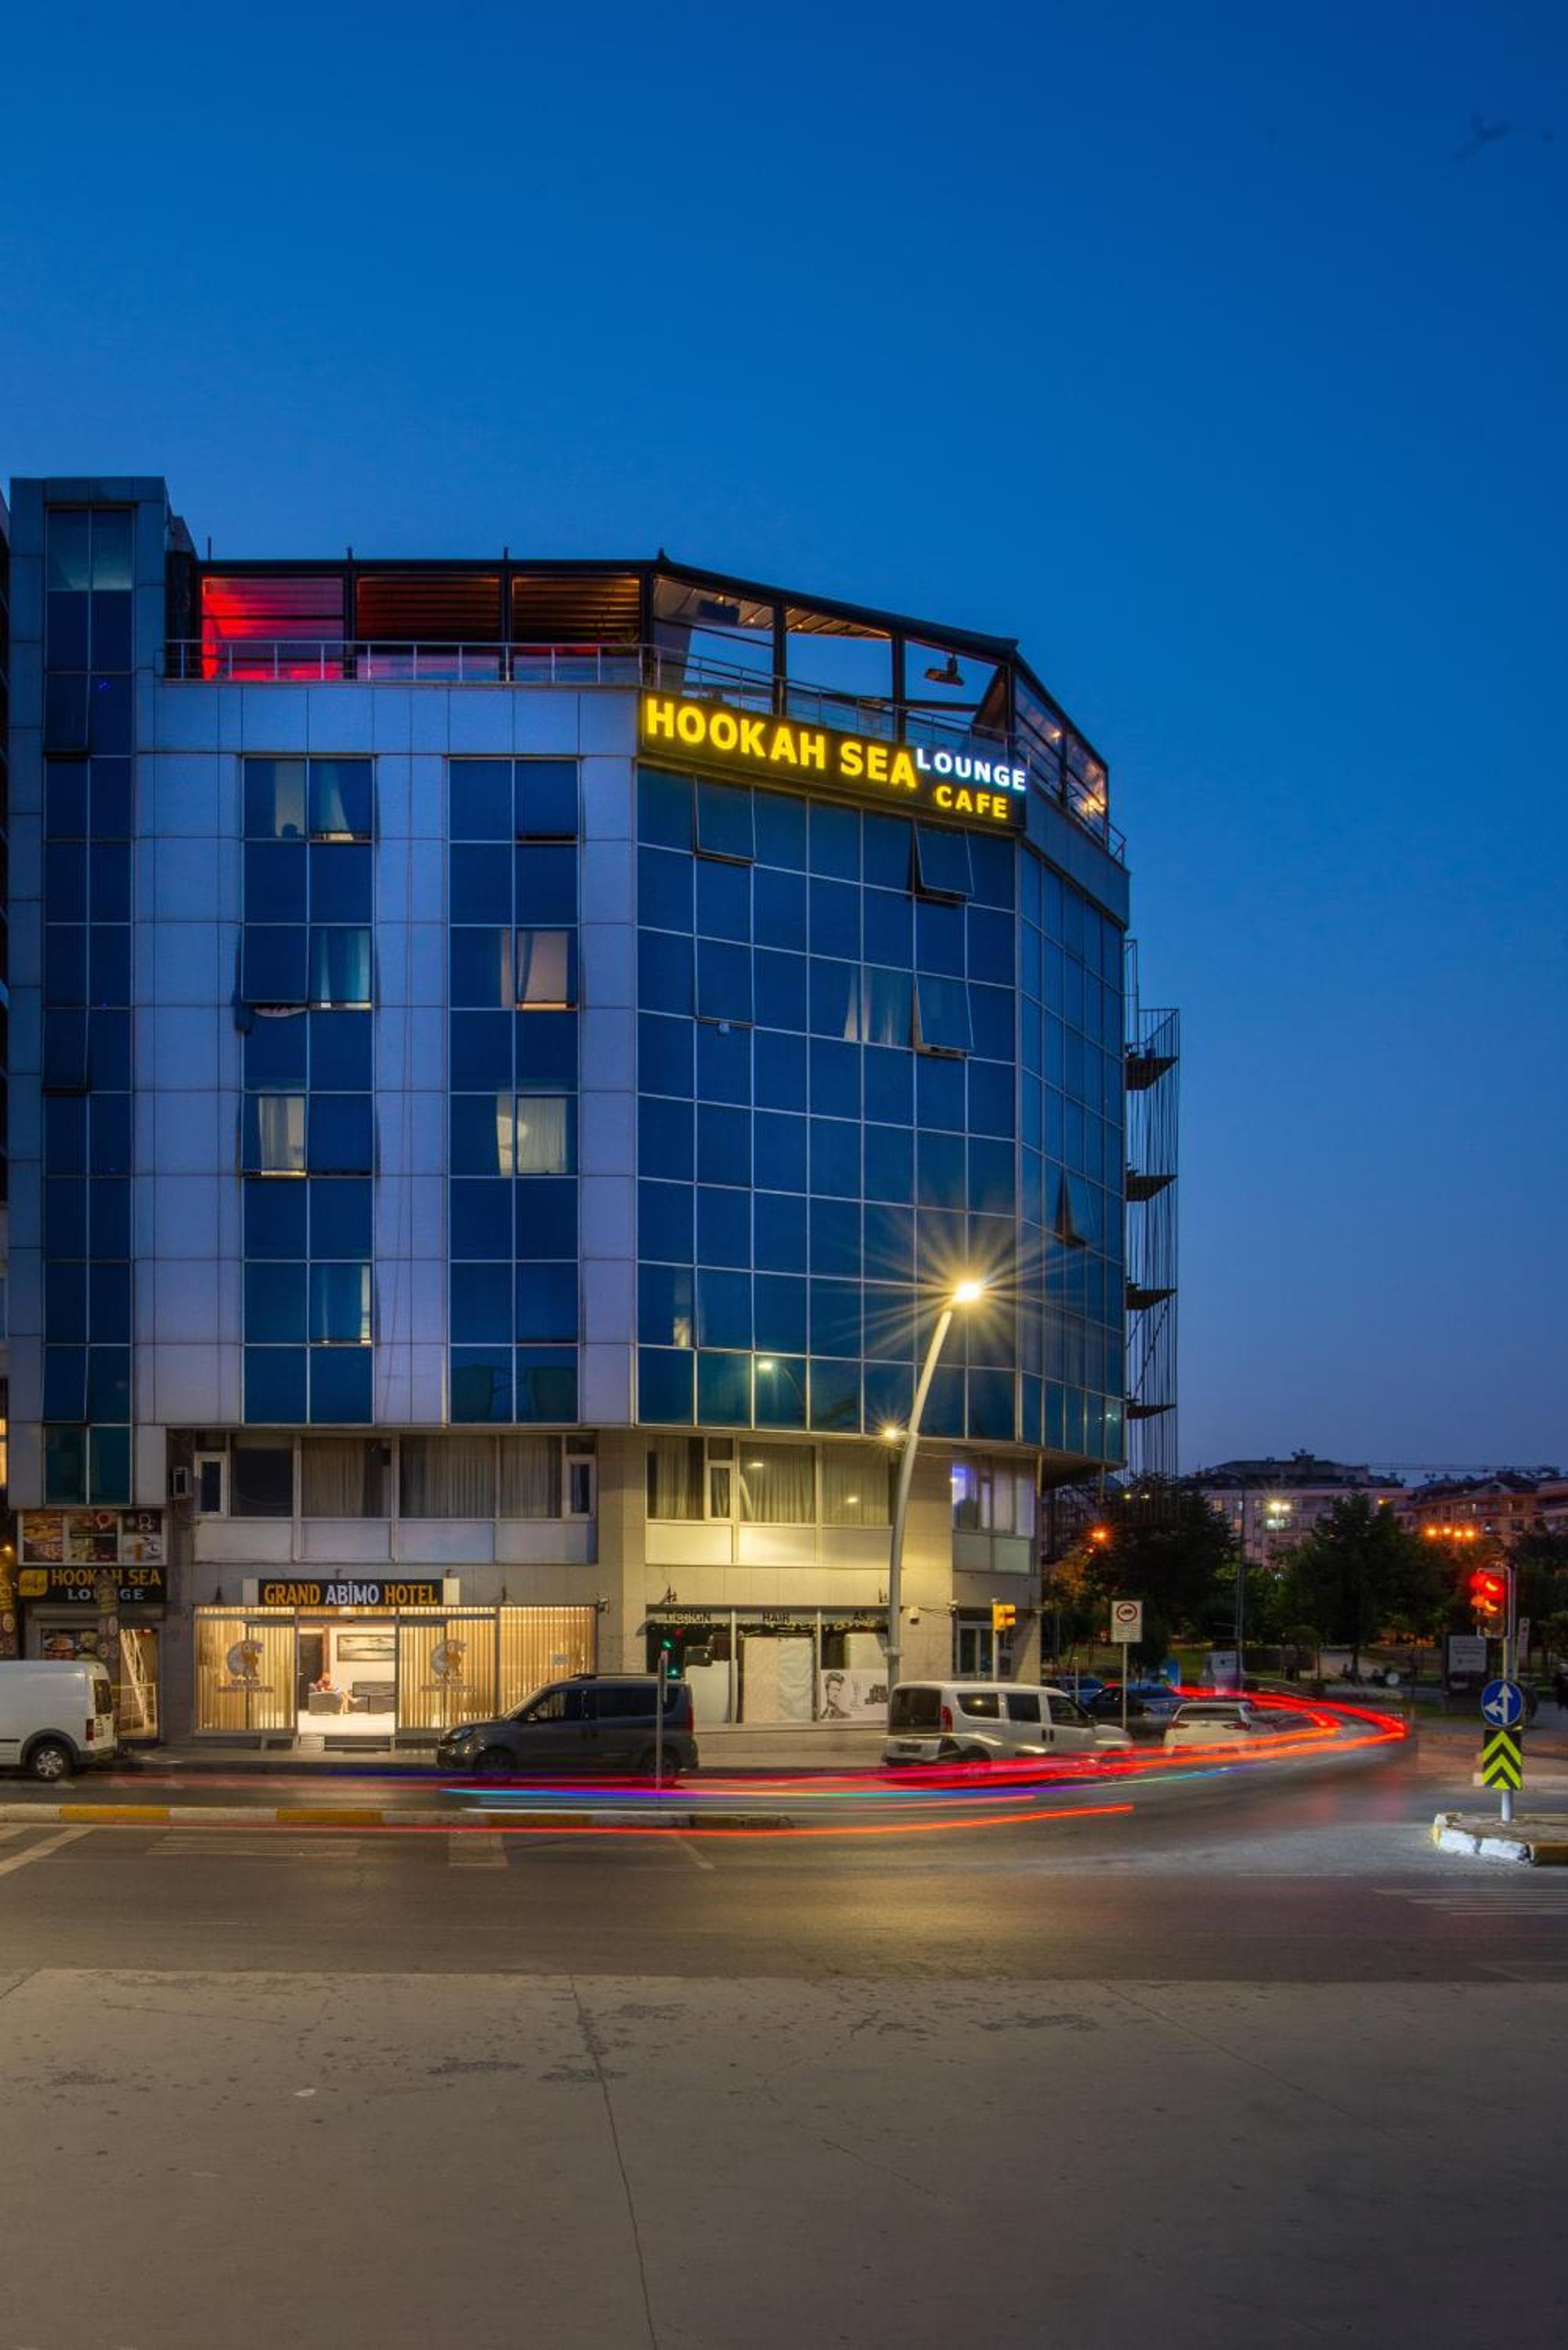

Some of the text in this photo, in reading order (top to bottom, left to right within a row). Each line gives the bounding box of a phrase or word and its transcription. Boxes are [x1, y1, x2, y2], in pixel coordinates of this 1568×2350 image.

[646, 699, 917, 789] HOOKAH SEA
[916, 747, 1026, 791] LOUNGE
[934, 785, 1007, 819] CAFE
[51, 1568, 161, 1586] HOOKH SEA
[67, 1588, 144, 1600] LOGE
[264, 1583, 320, 1605] GRAND
[385, 1583, 438, 1605] HOTEL
